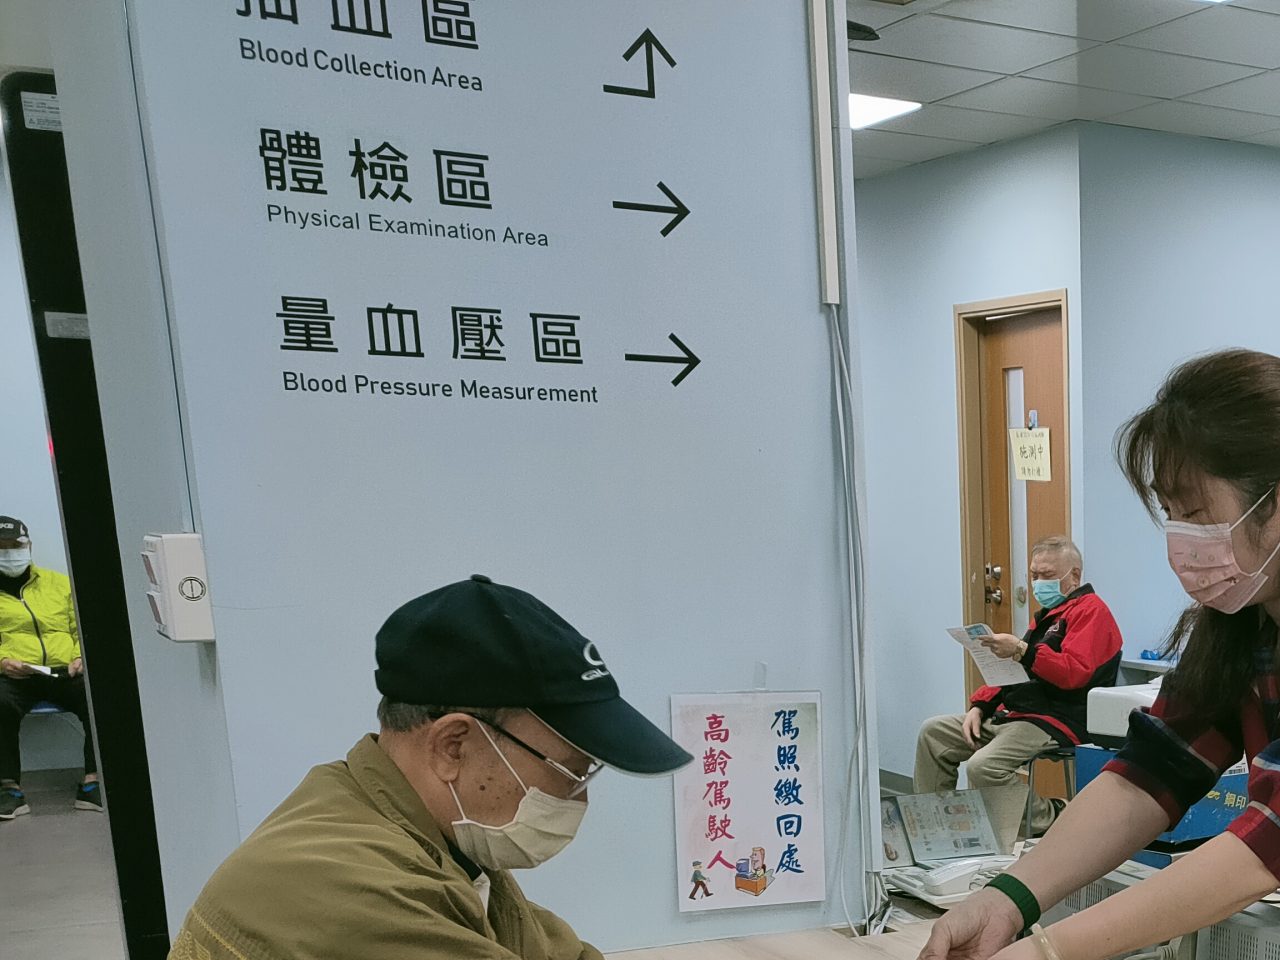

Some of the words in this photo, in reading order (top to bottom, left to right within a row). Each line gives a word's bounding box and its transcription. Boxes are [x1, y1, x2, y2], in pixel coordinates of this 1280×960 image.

[240, 38, 308, 67] Blood
[314, 50, 426, 84] Collection
[432, 67, 482, 91] Area
[259, 128, 492, 209] 體檢區
[267, 204, 359, 229] Physical
[369, 214, 495, 242] Examination
[503, 227, 548, 246] Area
[276, 296, 583, 364] 量血壓區
[283, 372, 347, 393] Blood
[355, 375, 452, 397] Pressure
[461, 380, 598, 403] Measurement
[703, 714, 736, 869] 高齡駕駛人
[771, 710, 804, 873] 駕照繳回處
